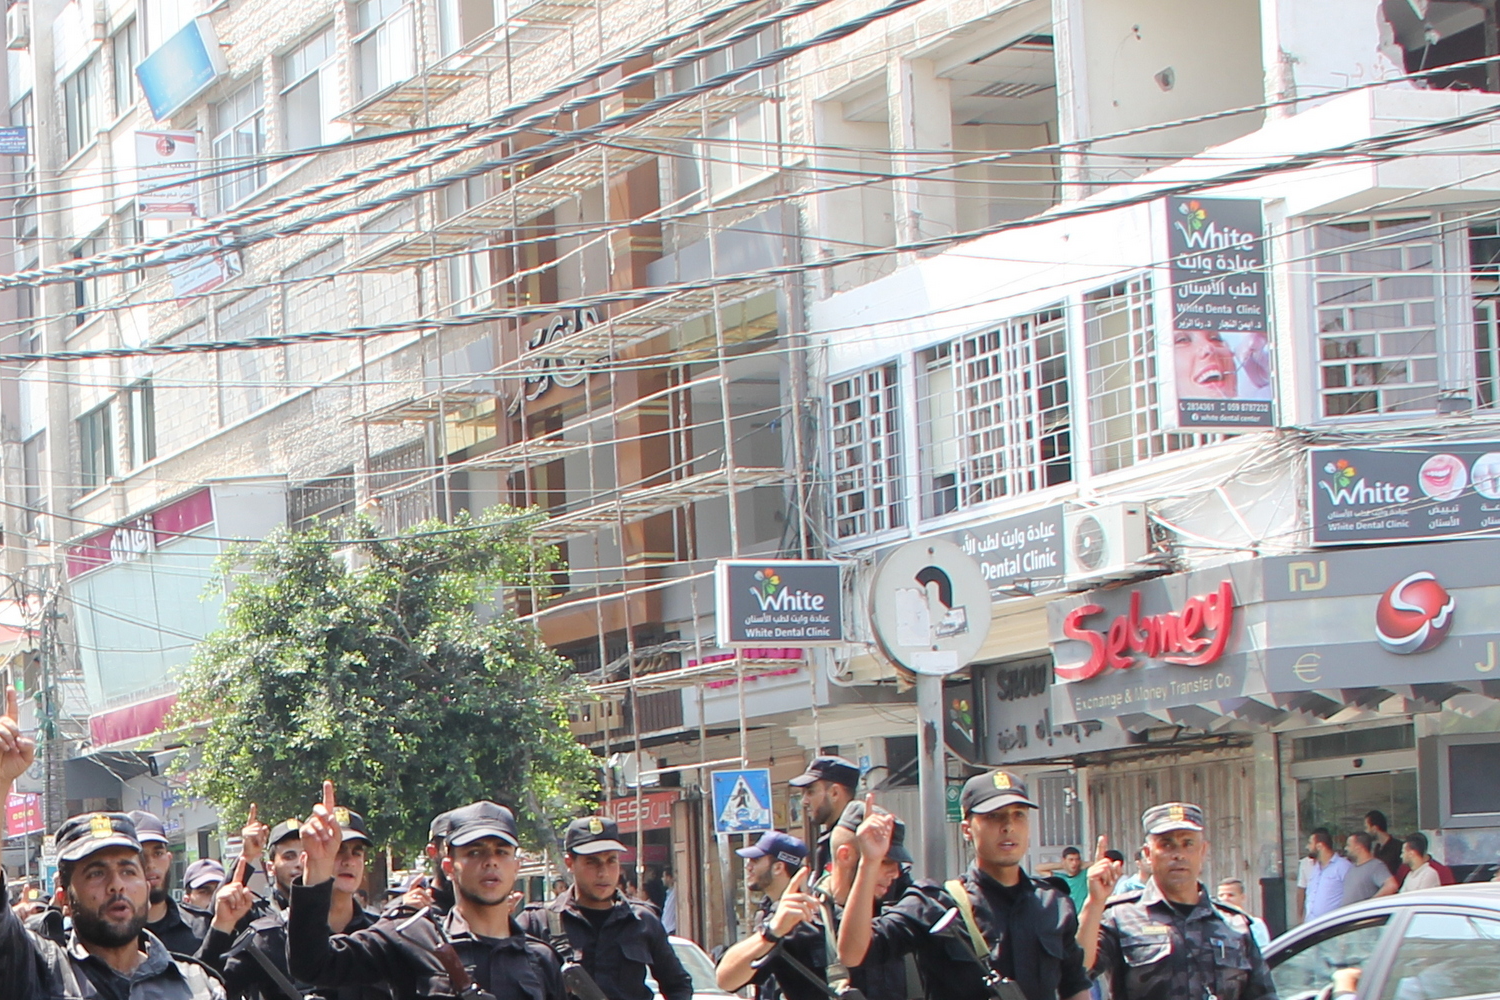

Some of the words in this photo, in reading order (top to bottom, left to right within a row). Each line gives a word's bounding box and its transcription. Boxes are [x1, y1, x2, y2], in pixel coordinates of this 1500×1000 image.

[1174, 220, 1254, 251] White
[1178, 278, 1225, 298] الأسنان
[1228, 281, 1257, 299] لطب
[1176, 303, 1204, 313] White
[1236, 304, 1261, 315] Clinic
[1318, 477, 1410, 506] White
[1428, 504, 1459, 516] تبييض
[1026, 521, 1056, 543] عيادة
[1328, 522, 1354, 531] White
[1356, 520, 1384, 530] Dental
[1386, 519, 1410, 529] Clinic
[1428, 517, 1460, 530] الأسنان
[978, 532, 999, 557] لطب
[1001, 528, 1025, 551] وايت
[980, 553, 1021, 581] Dental
[1022, 547, 1057, 573] Clinic
[749, 585, 825, 611] White
[744, 612, 772, 626] الأسنان
[772, 614, 790, 623] لطب
[790, 614, 809, 625] وايت
[809, 614, 831, 624] عيادة
[745, 627, 774, 638] White
[774, 627, 805, 637] Dental
[806, 626, 831, 637] Clinic
[1170, 676, 1214, 696] Transfer
[1215, 672, 1232, 688] Co
